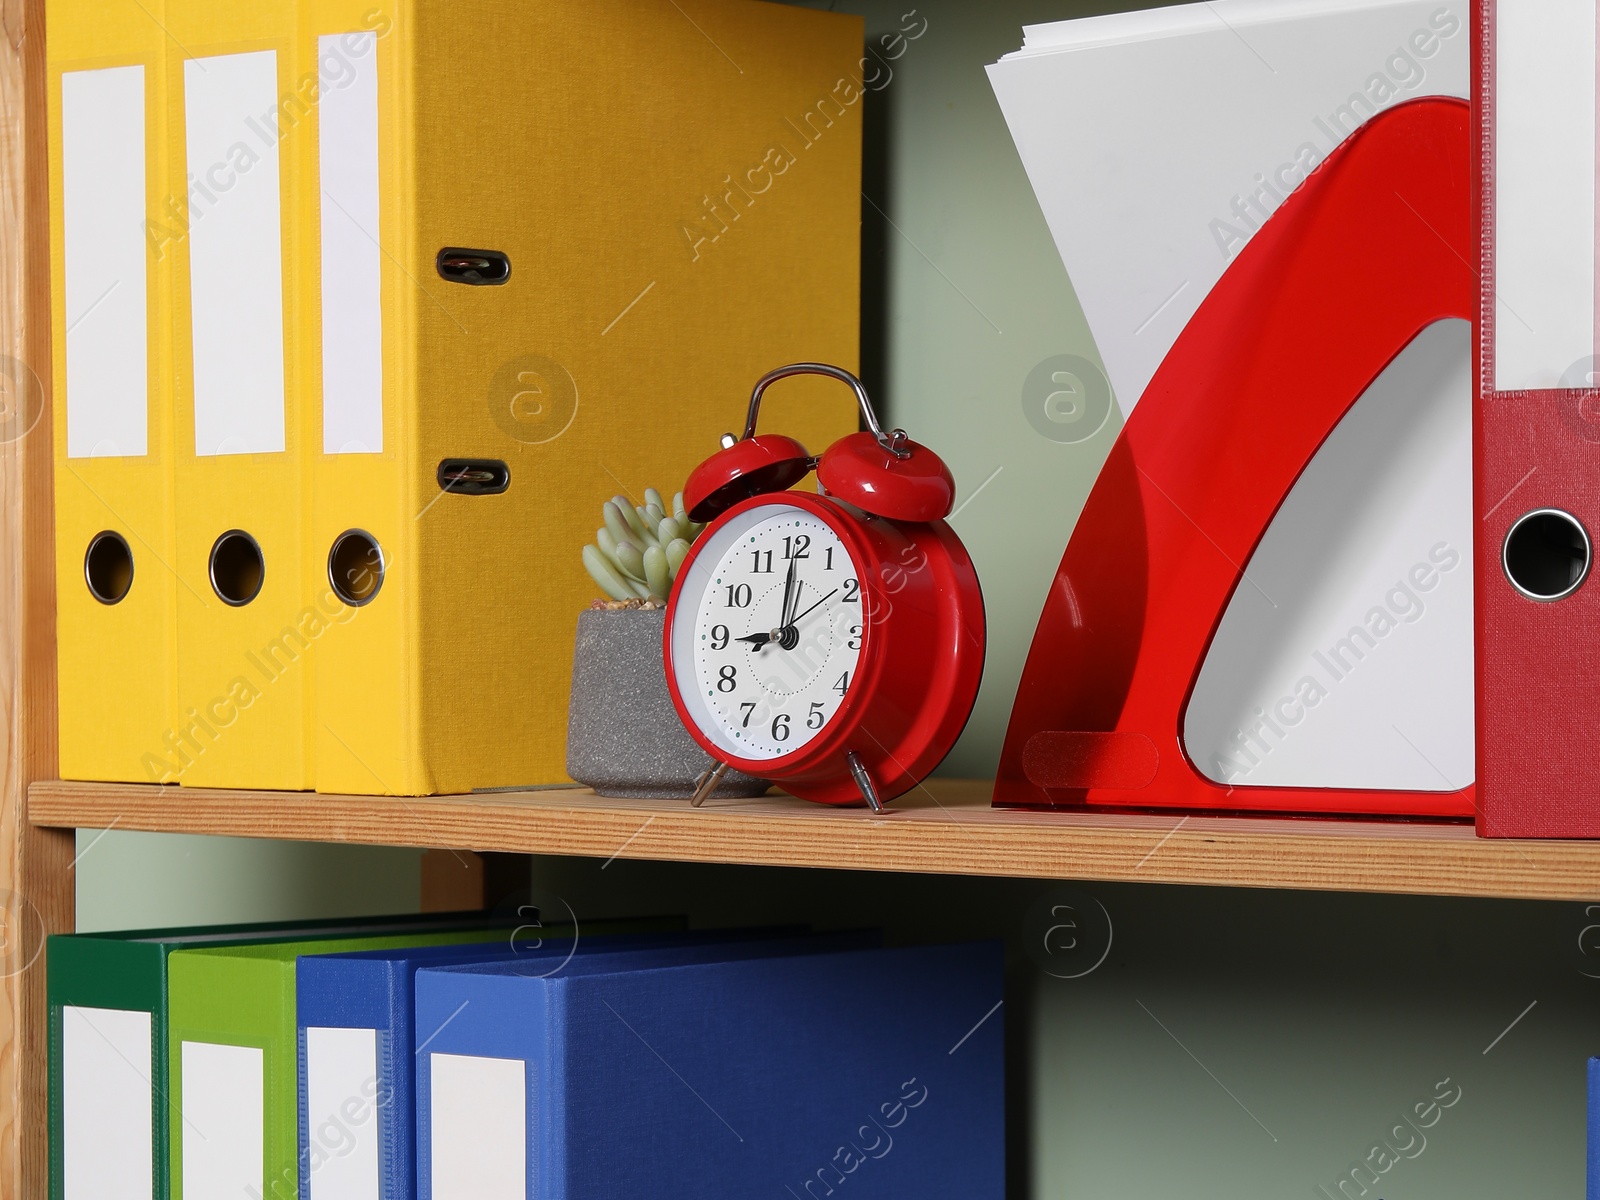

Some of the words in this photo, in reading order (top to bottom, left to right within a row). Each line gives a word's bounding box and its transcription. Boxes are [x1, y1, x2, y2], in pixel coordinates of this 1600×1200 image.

[781, 535, 810, 559] 12
[824, 547, 834, 570] 1
[750, 550, 775, 573] 11
[724, 583, 752, 608] 10
[842, 578, 859, 603] 2
[711, 624, 730, 650] 9
[849, 625, 862, 649] 3
[717, 665, 737, 692] 8
[833, 671, 848, 696] 4
[740, 702, 756, 727] 7
[807, 702, 824, 729] 5
[771, 714, 790, 741] 6
